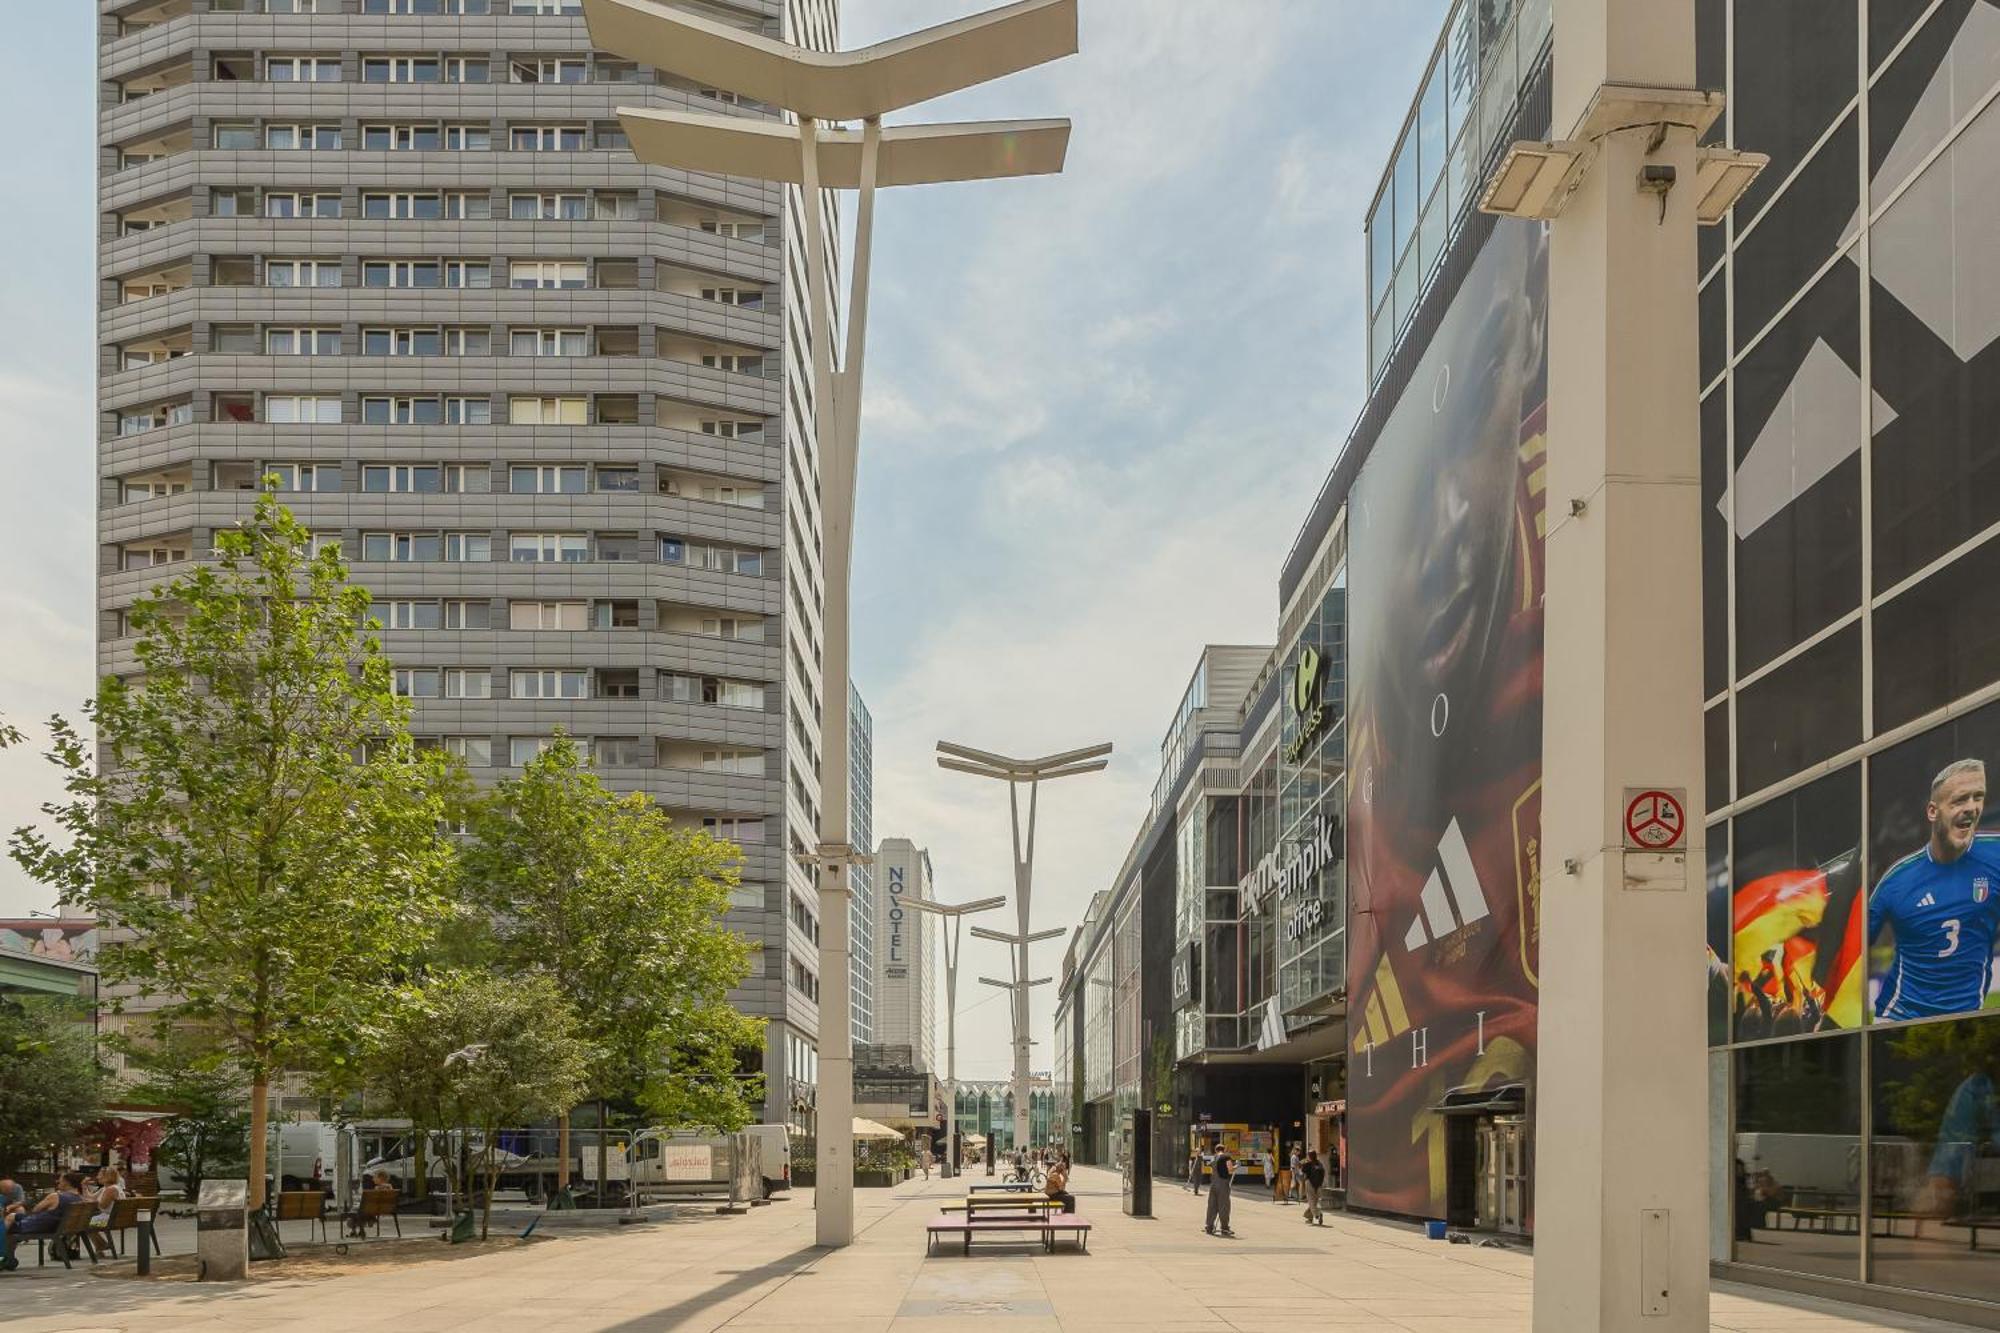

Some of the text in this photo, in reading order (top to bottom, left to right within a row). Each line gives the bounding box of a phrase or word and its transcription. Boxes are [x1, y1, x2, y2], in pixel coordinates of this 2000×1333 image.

[1278, 814, 1334, 901] empik
[889, 867, 903, 961] NOVOTEL
[1287, 898, 1322, 942] office
[1937, 918, 1961, 959] 3
[1363, 1010, 1487, 1078] THI
